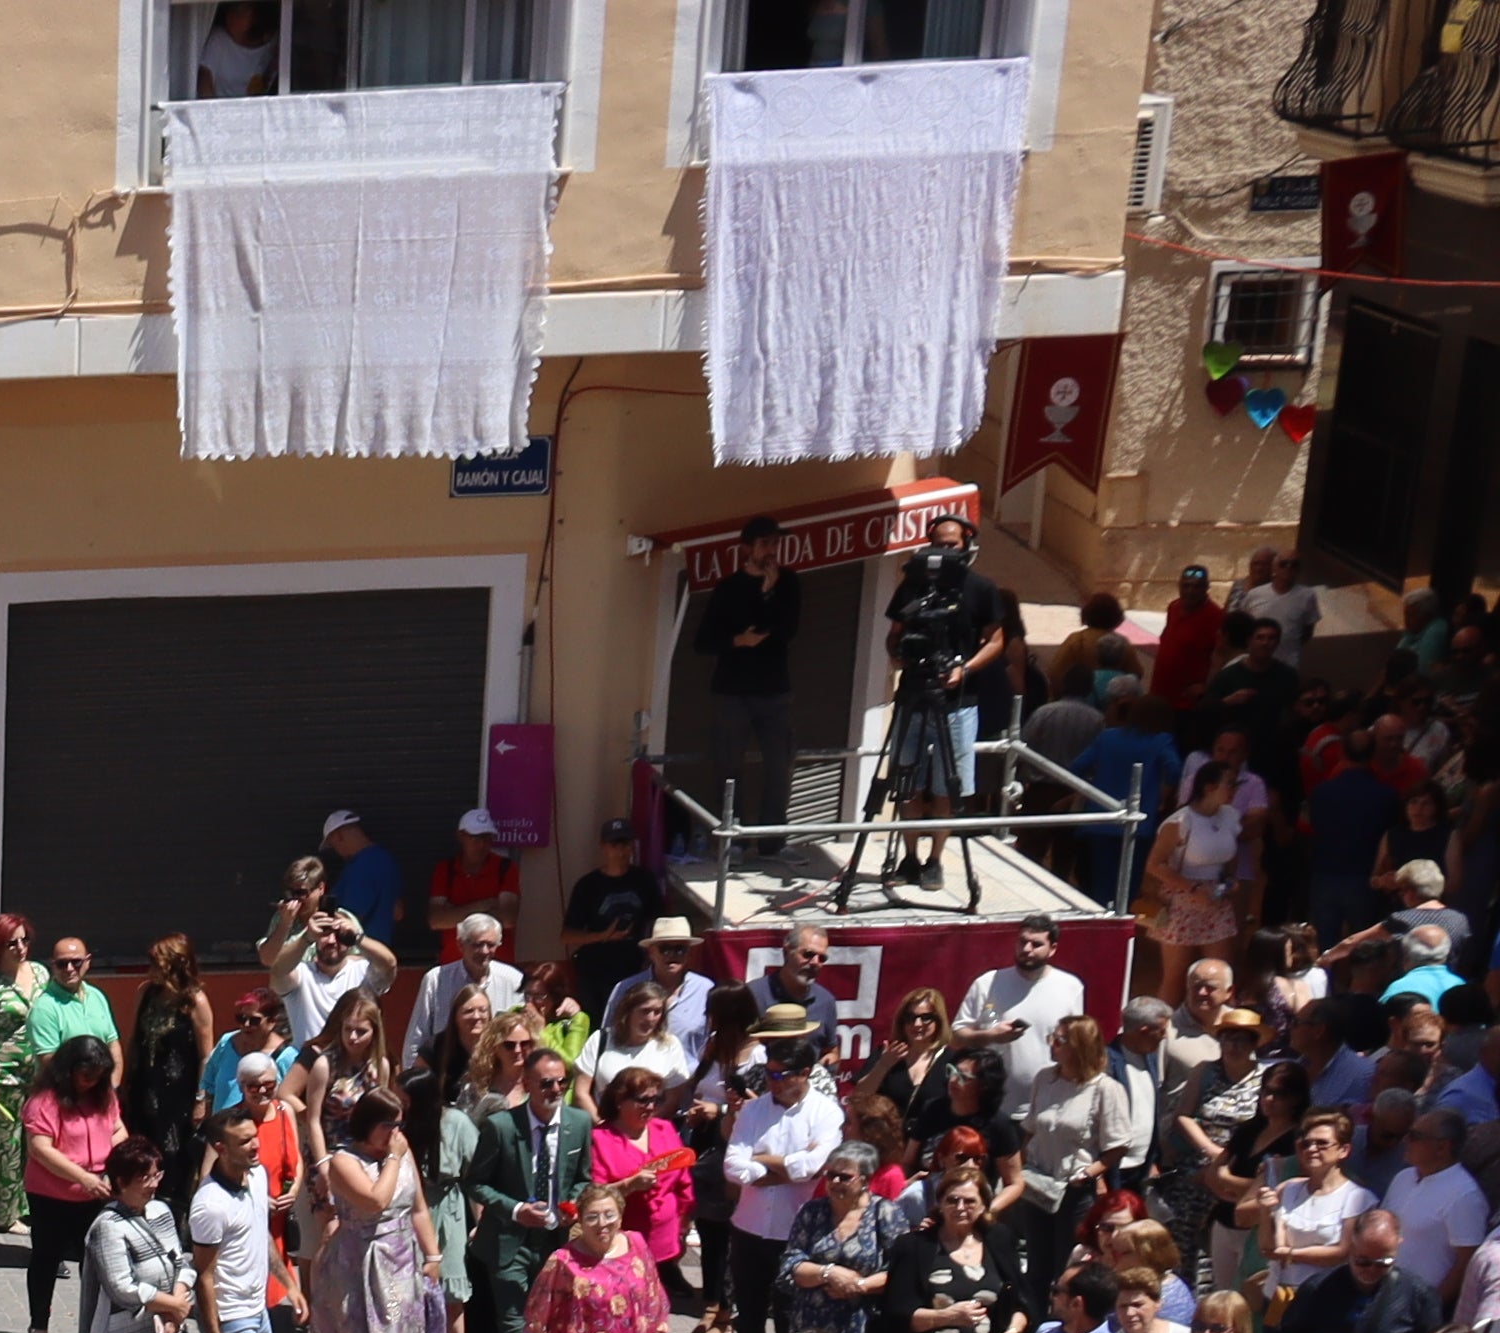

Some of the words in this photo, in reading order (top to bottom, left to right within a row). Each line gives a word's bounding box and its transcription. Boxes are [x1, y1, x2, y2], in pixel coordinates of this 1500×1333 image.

[456, 468, 500, 487] RAMÓN
[502, 471, 510, 486] Y
[511, 469, 544, 486] CAJAL
[695, 549, 722, 582] LA
[726, 531, 814, 574] TDA
[826, 522, 855, 558] DE
[495, 817, 533, 828] entido
